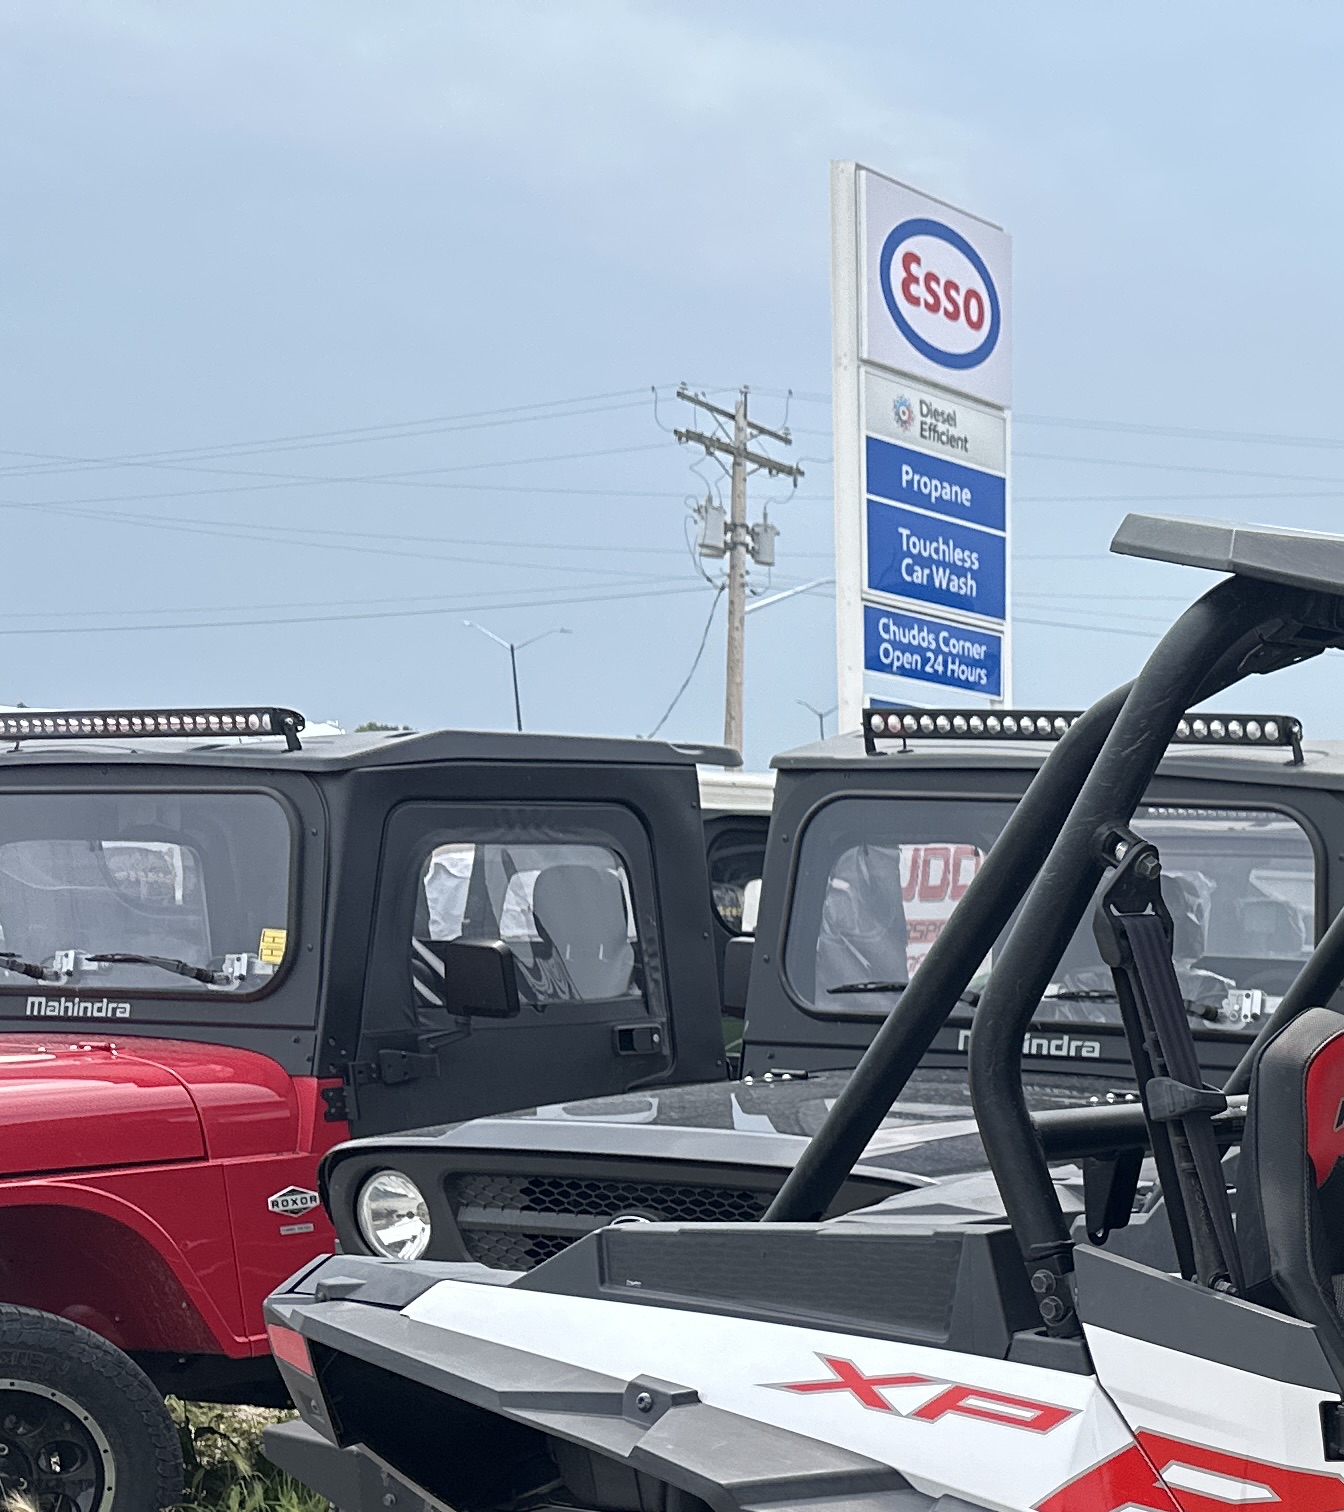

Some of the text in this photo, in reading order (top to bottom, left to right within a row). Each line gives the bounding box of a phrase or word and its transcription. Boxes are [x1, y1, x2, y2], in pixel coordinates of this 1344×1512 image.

[919, 399, 957, 427] Diesel
[919, 421, 969, 453] Efficient
[901, 464, 972, 507] Propane
[898, 527, 980, 570] Touchless
[901, 558, 977, 598] Car Wash
[878, 617, 987, 660] Chudds Corner
[879, 643, 988, 685] Open 24 Hours
[25, 996, 131, 1018] Mahindra
[957, 1029, 1101, 1058] indra
[271, 1195, 318, 1209] ROXOR
[758, 1352, 1083, 1435] XP
